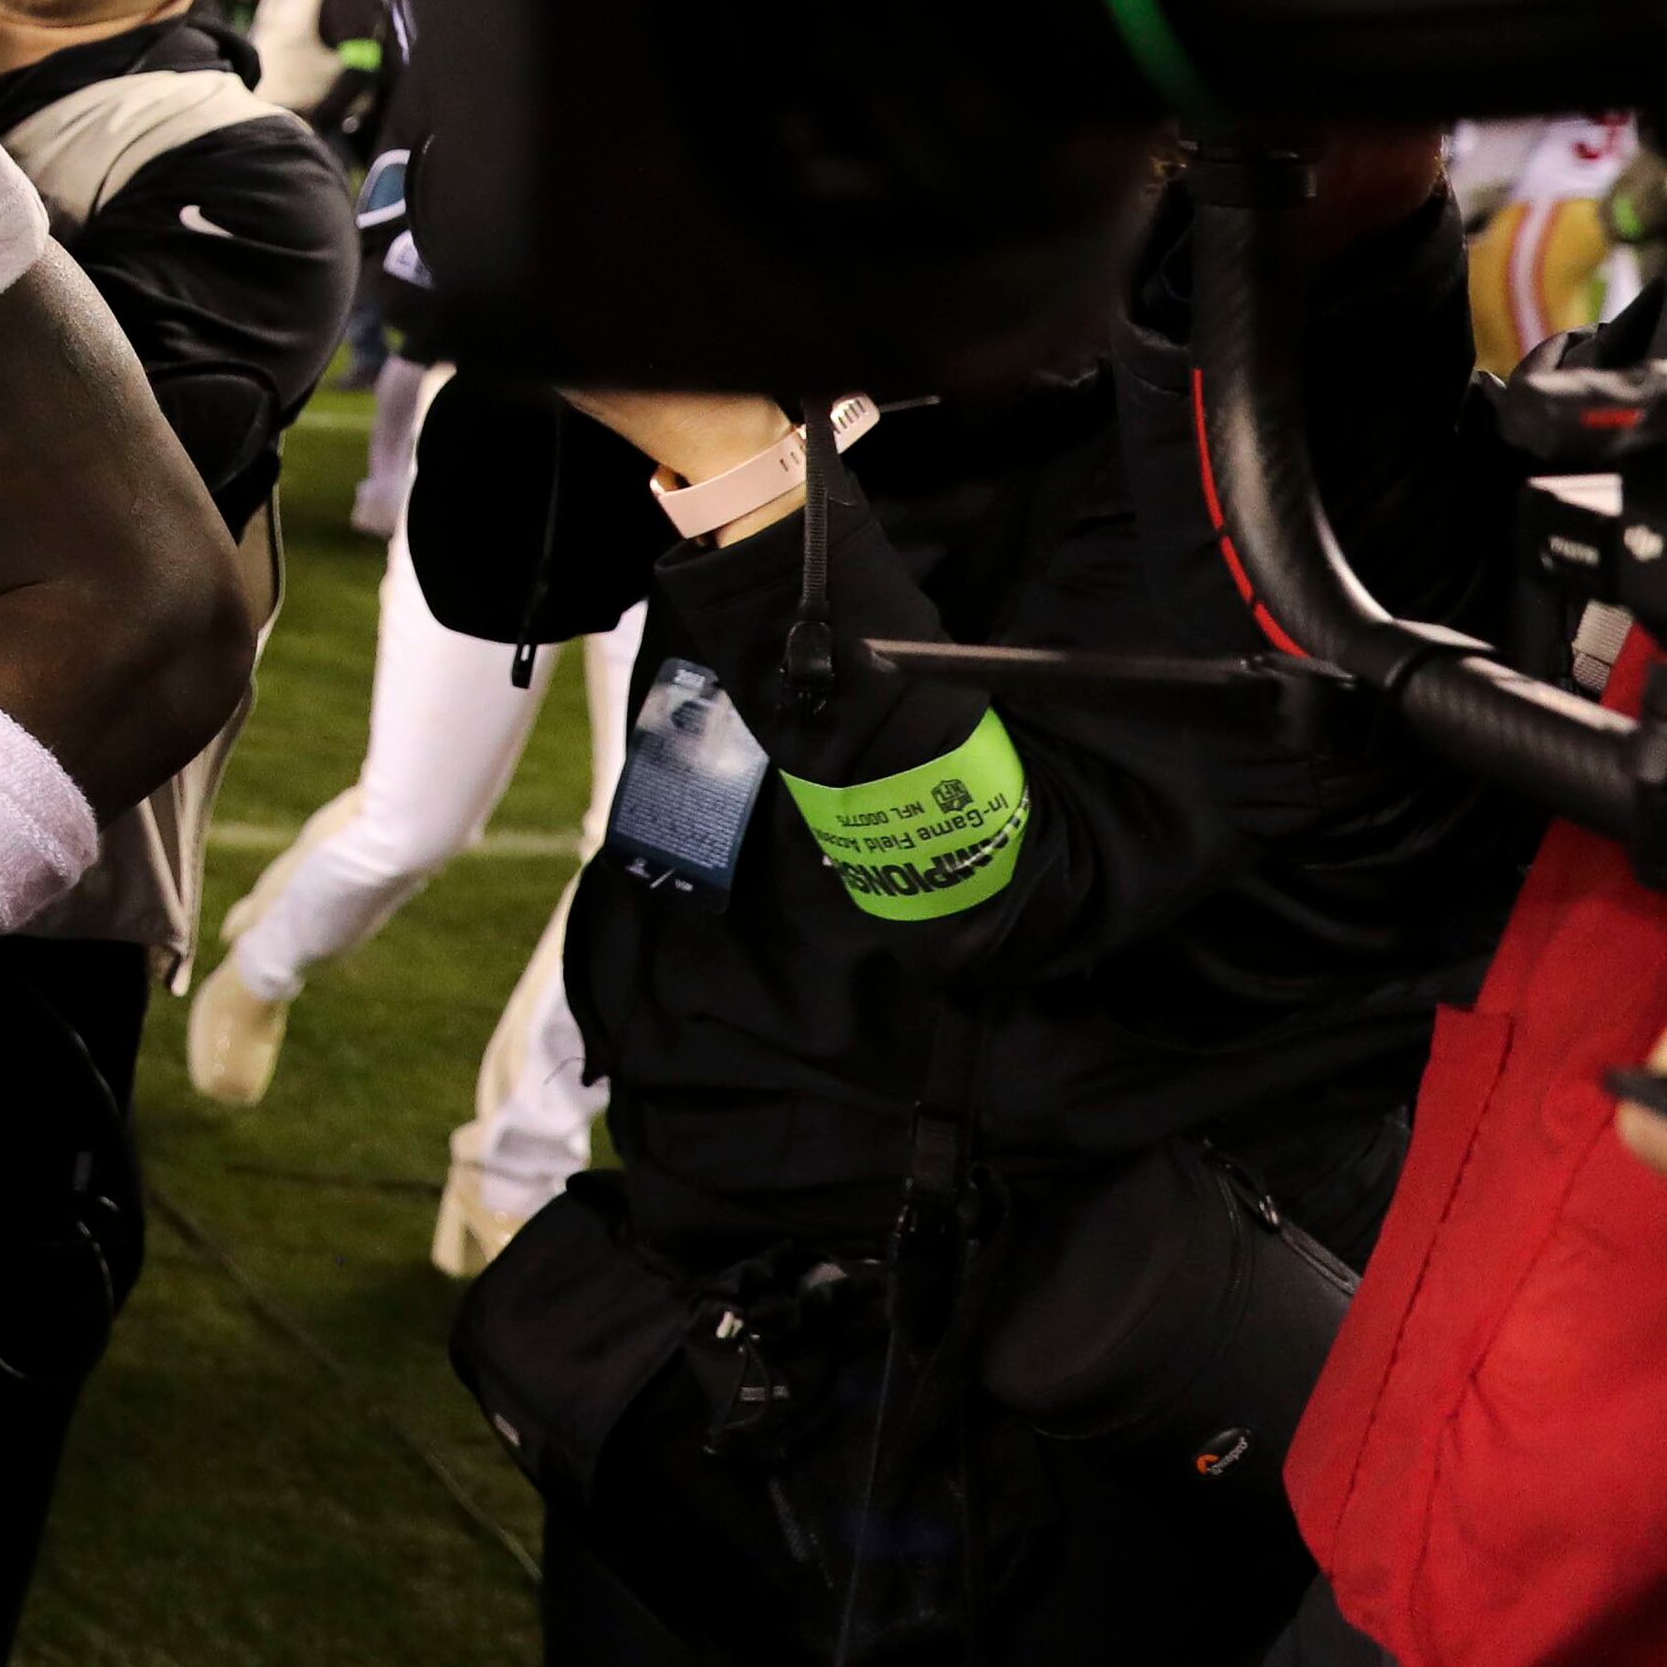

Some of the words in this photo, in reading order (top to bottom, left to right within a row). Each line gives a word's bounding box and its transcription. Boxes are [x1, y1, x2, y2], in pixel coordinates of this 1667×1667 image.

[891, 800, 926, 820] NFL
[919, 792, 1009, 841] In-Game
[867, 831, 917, 854] Field
